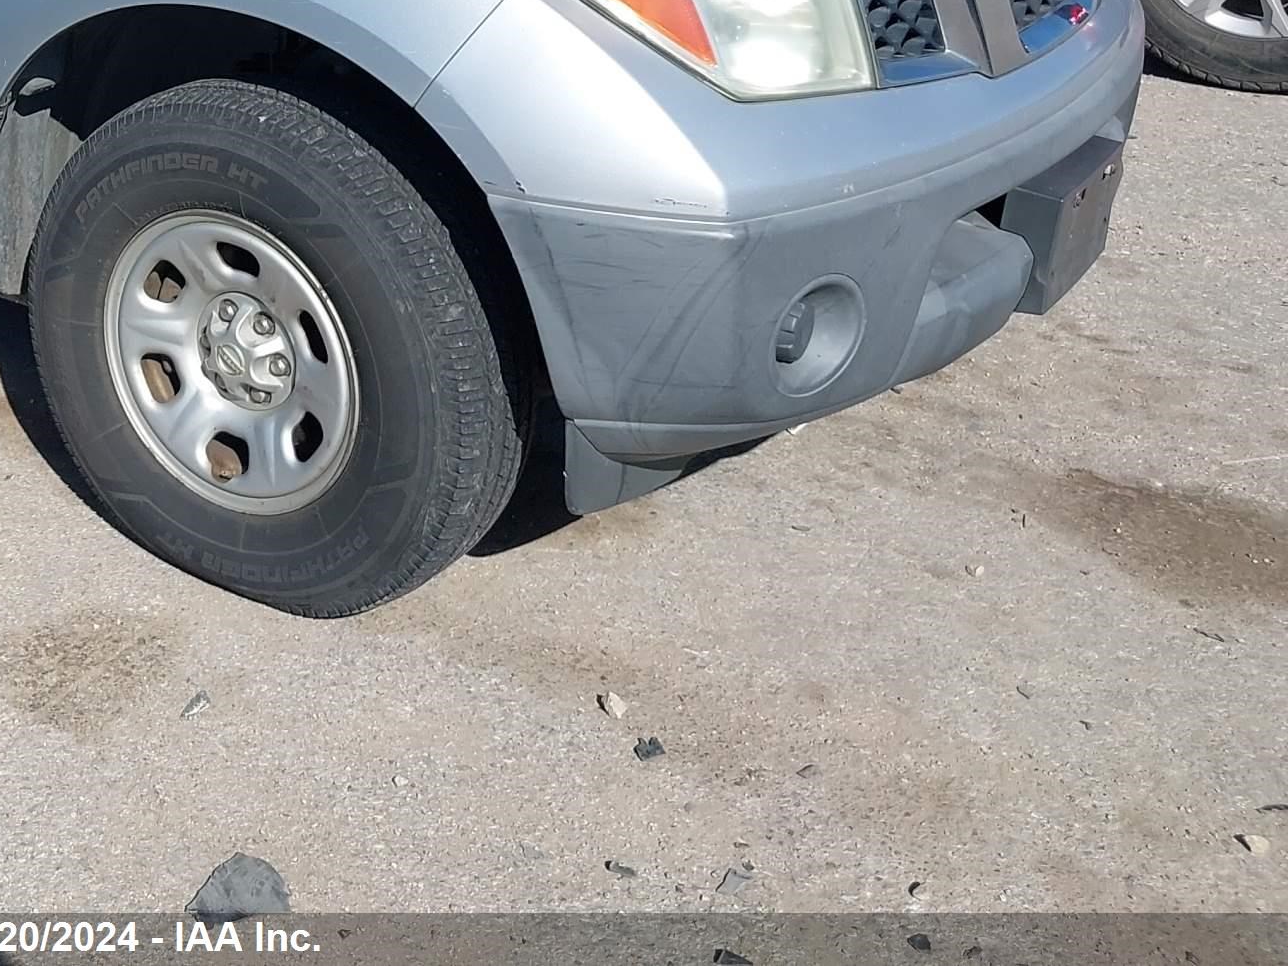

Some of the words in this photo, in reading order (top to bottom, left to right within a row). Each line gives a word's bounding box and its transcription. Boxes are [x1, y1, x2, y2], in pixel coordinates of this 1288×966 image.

[74, 152, 219, 224] PATHFINDER
[226, 161, 268, 191] HT
[200, 525, 370, 583] PATHFINDER
